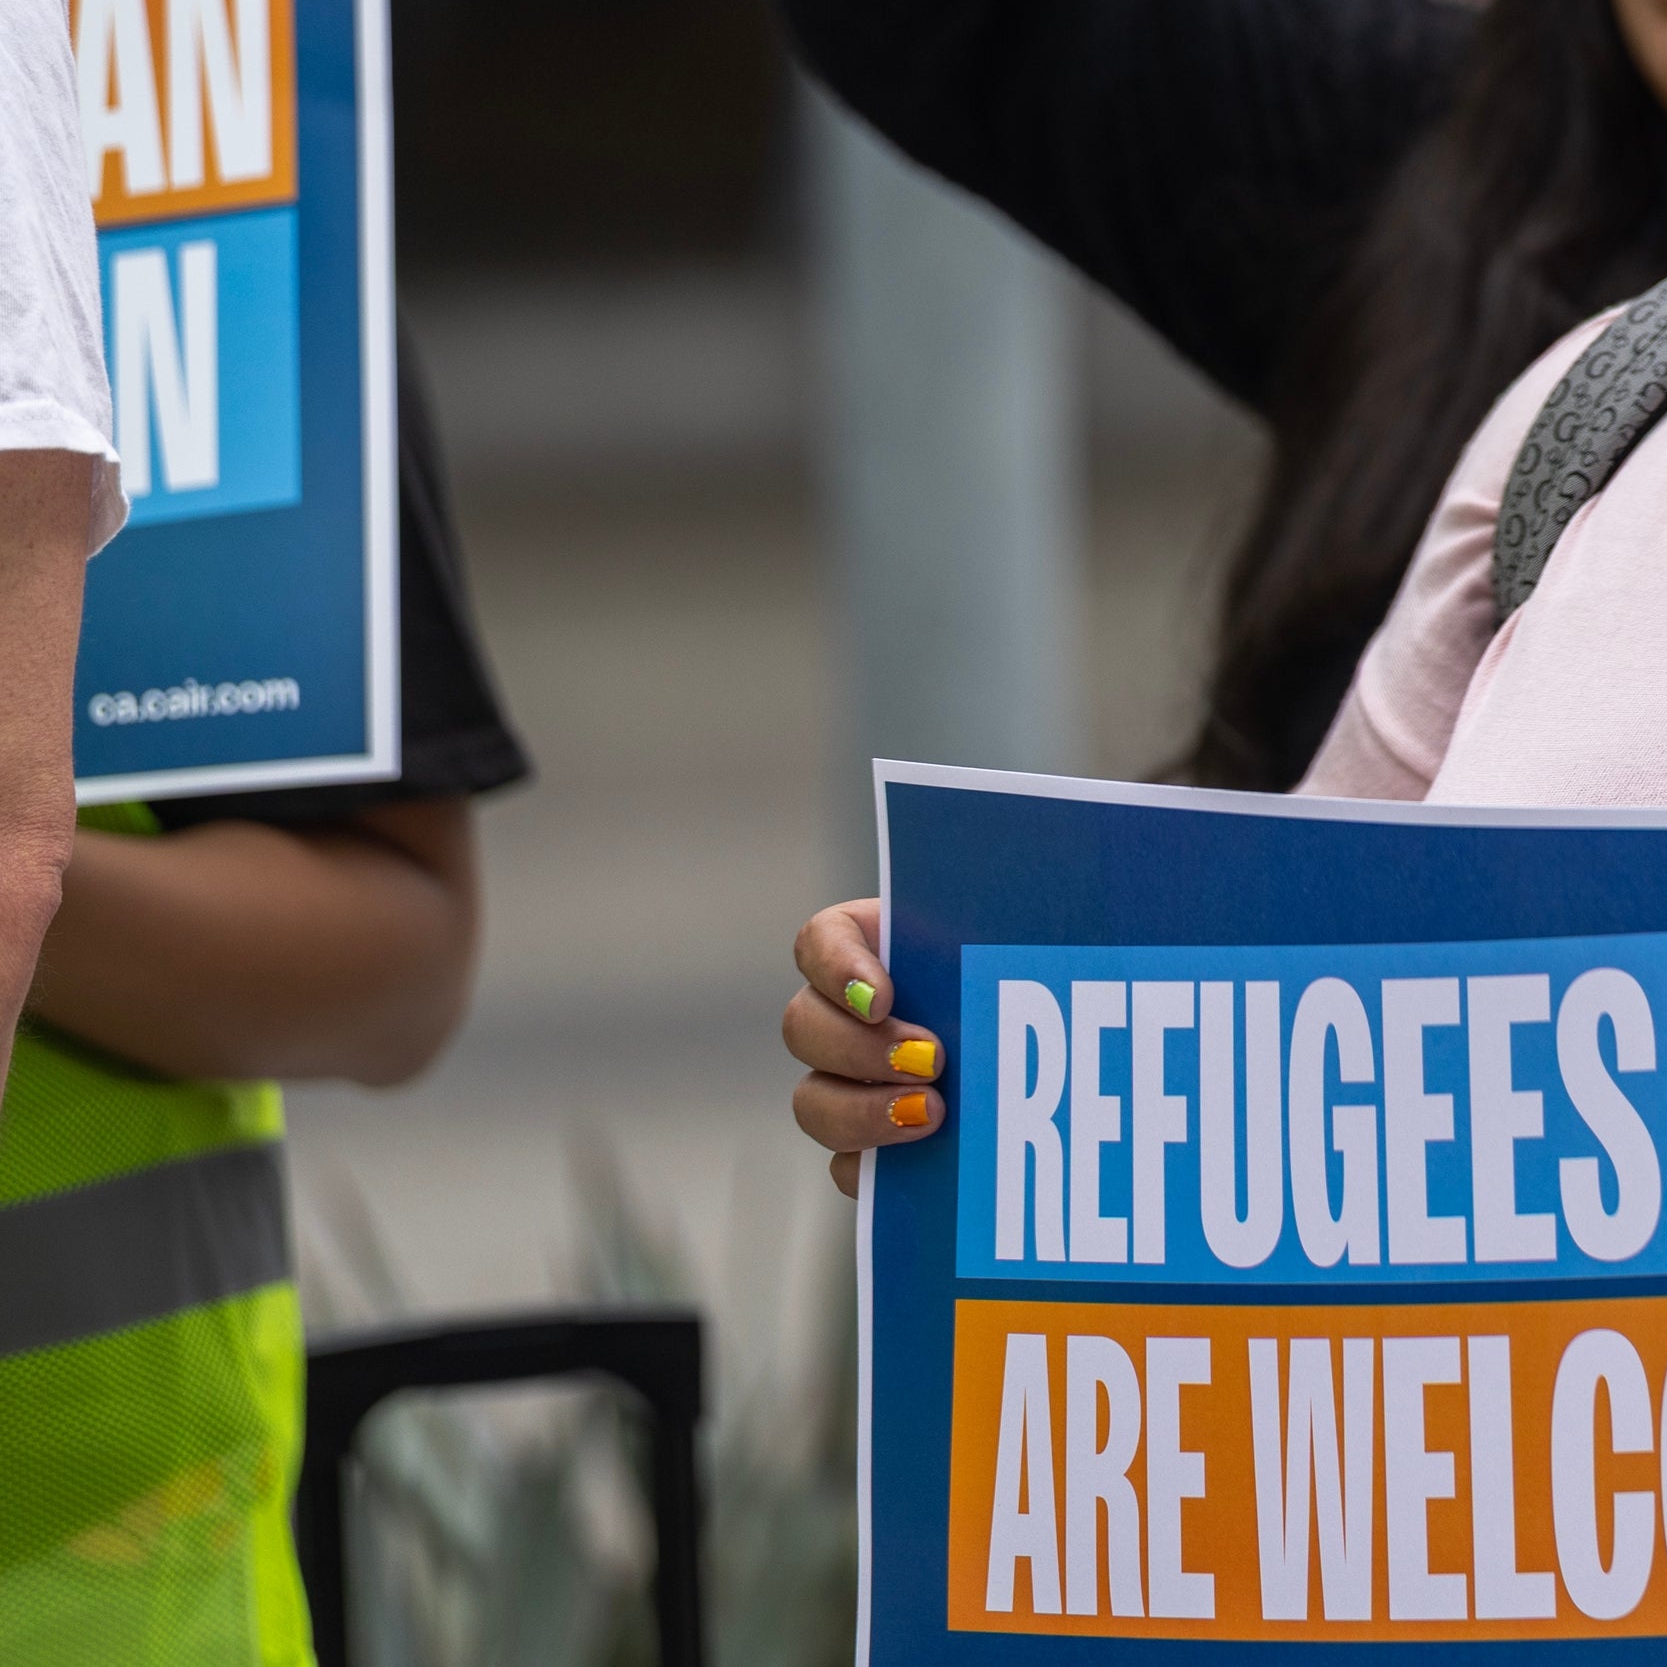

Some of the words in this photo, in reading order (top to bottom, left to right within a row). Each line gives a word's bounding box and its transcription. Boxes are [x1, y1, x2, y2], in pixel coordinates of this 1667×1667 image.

[88, 676, 301, 727] ca.cair.com
[994, 966, 1664, 1270] REFUGEES
[984, 1331, 1217, 1621] ARE
